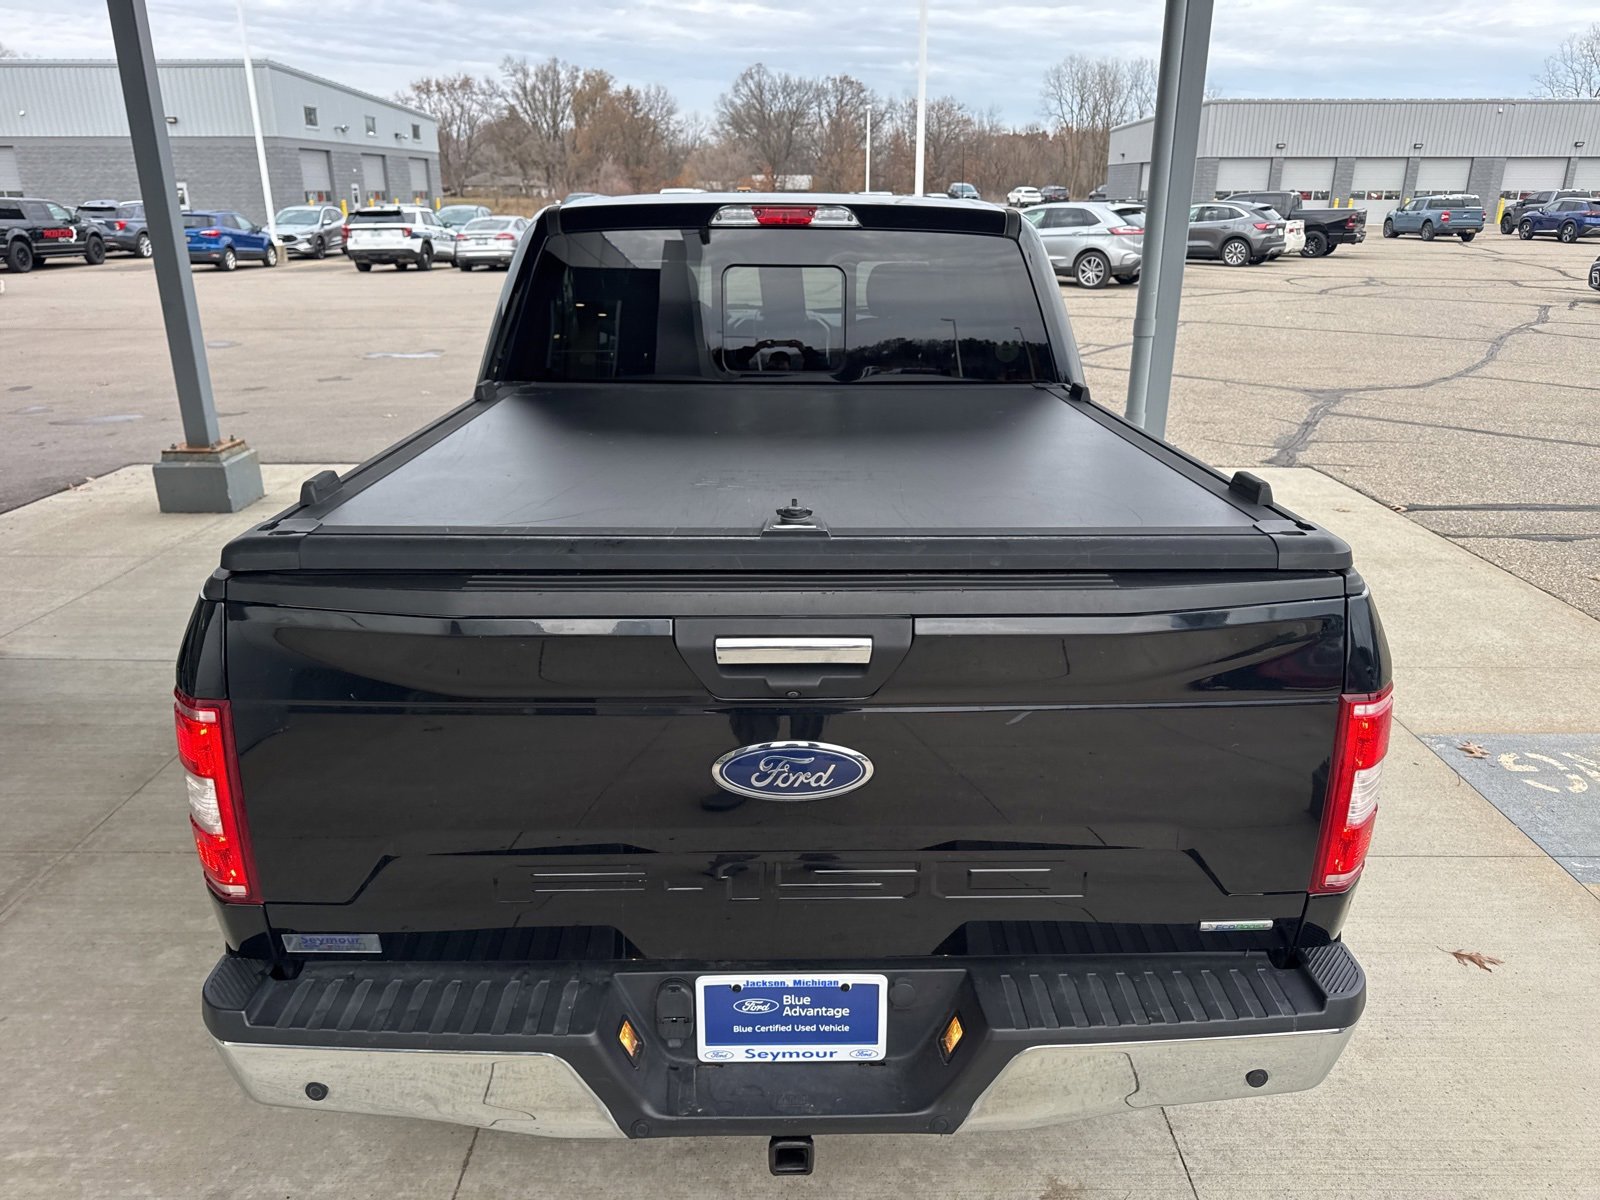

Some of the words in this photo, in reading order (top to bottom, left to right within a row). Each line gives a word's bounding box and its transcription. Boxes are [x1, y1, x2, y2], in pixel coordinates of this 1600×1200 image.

[750, 755, 836, 788] Ford
[300, 936, 360, 946] Seymour
[743, 979, 789, 988] Jackson,
[793, 979, 839, 988] Michigan
[783, 994, 811, 1005] Blue
[742, 1000, 771, 1012] Ford
[782, 1006, 850, 1018] Advantage
[733, 1025, 753, 1033] Blue
[755, 1024, 792, 1033] Certified
[794, 1024, 816, 1032] Used
[818, 1024, 850, 1032] Vehicle
[744, 1048, 838, 1061] Seymour
